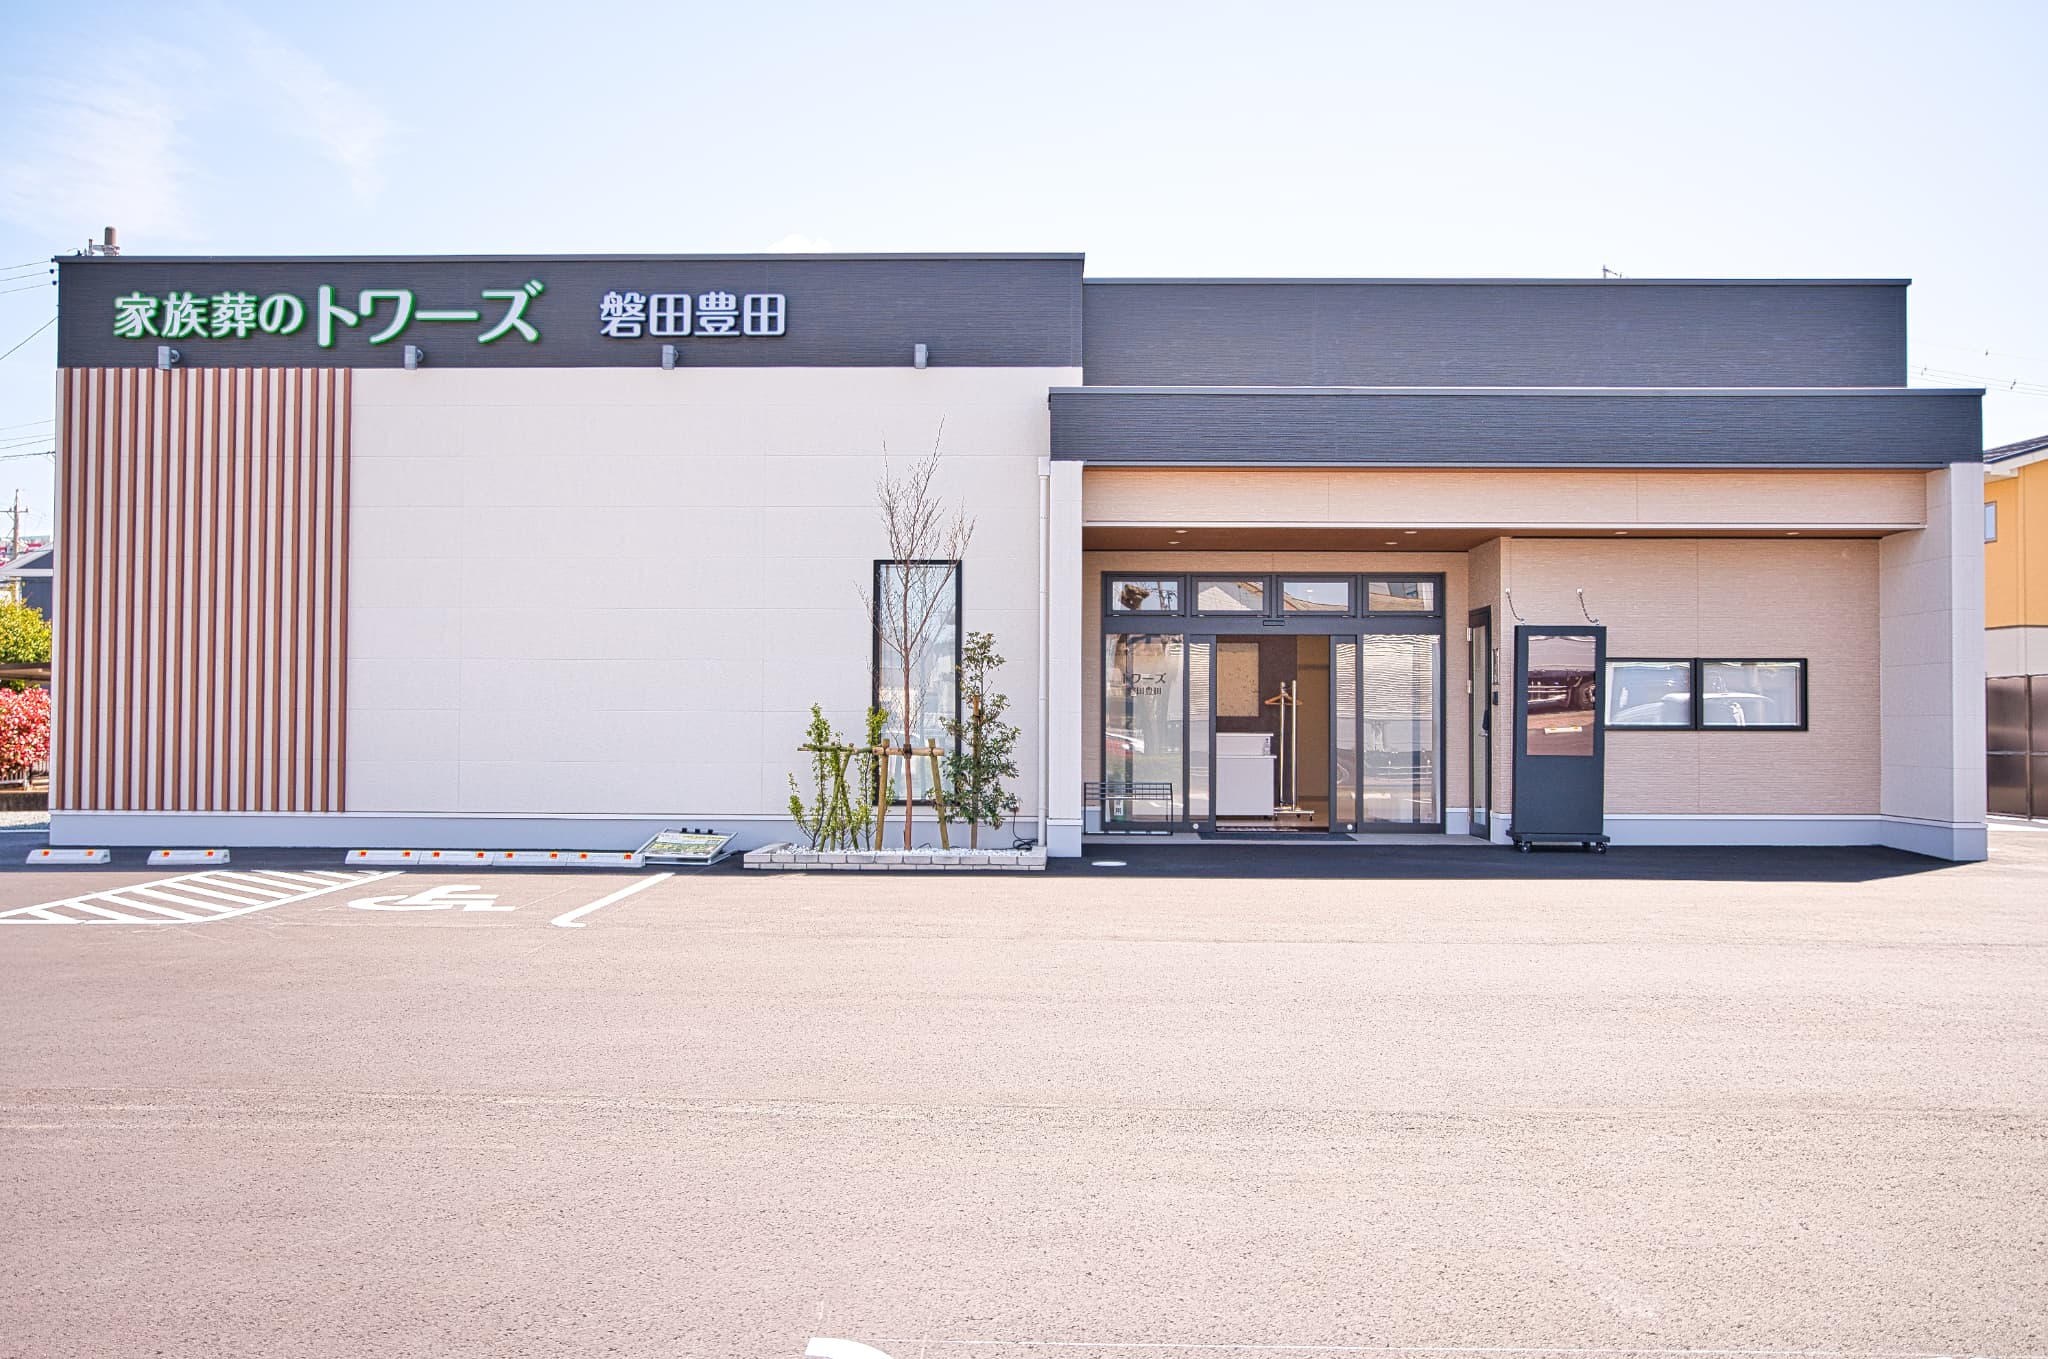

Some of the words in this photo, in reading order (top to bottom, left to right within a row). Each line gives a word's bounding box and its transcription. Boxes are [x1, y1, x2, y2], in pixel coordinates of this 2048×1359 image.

[113, 279, 544, 348] 家族葬のトワーズ
[599, 291, 787, 338] 磐田豊田
